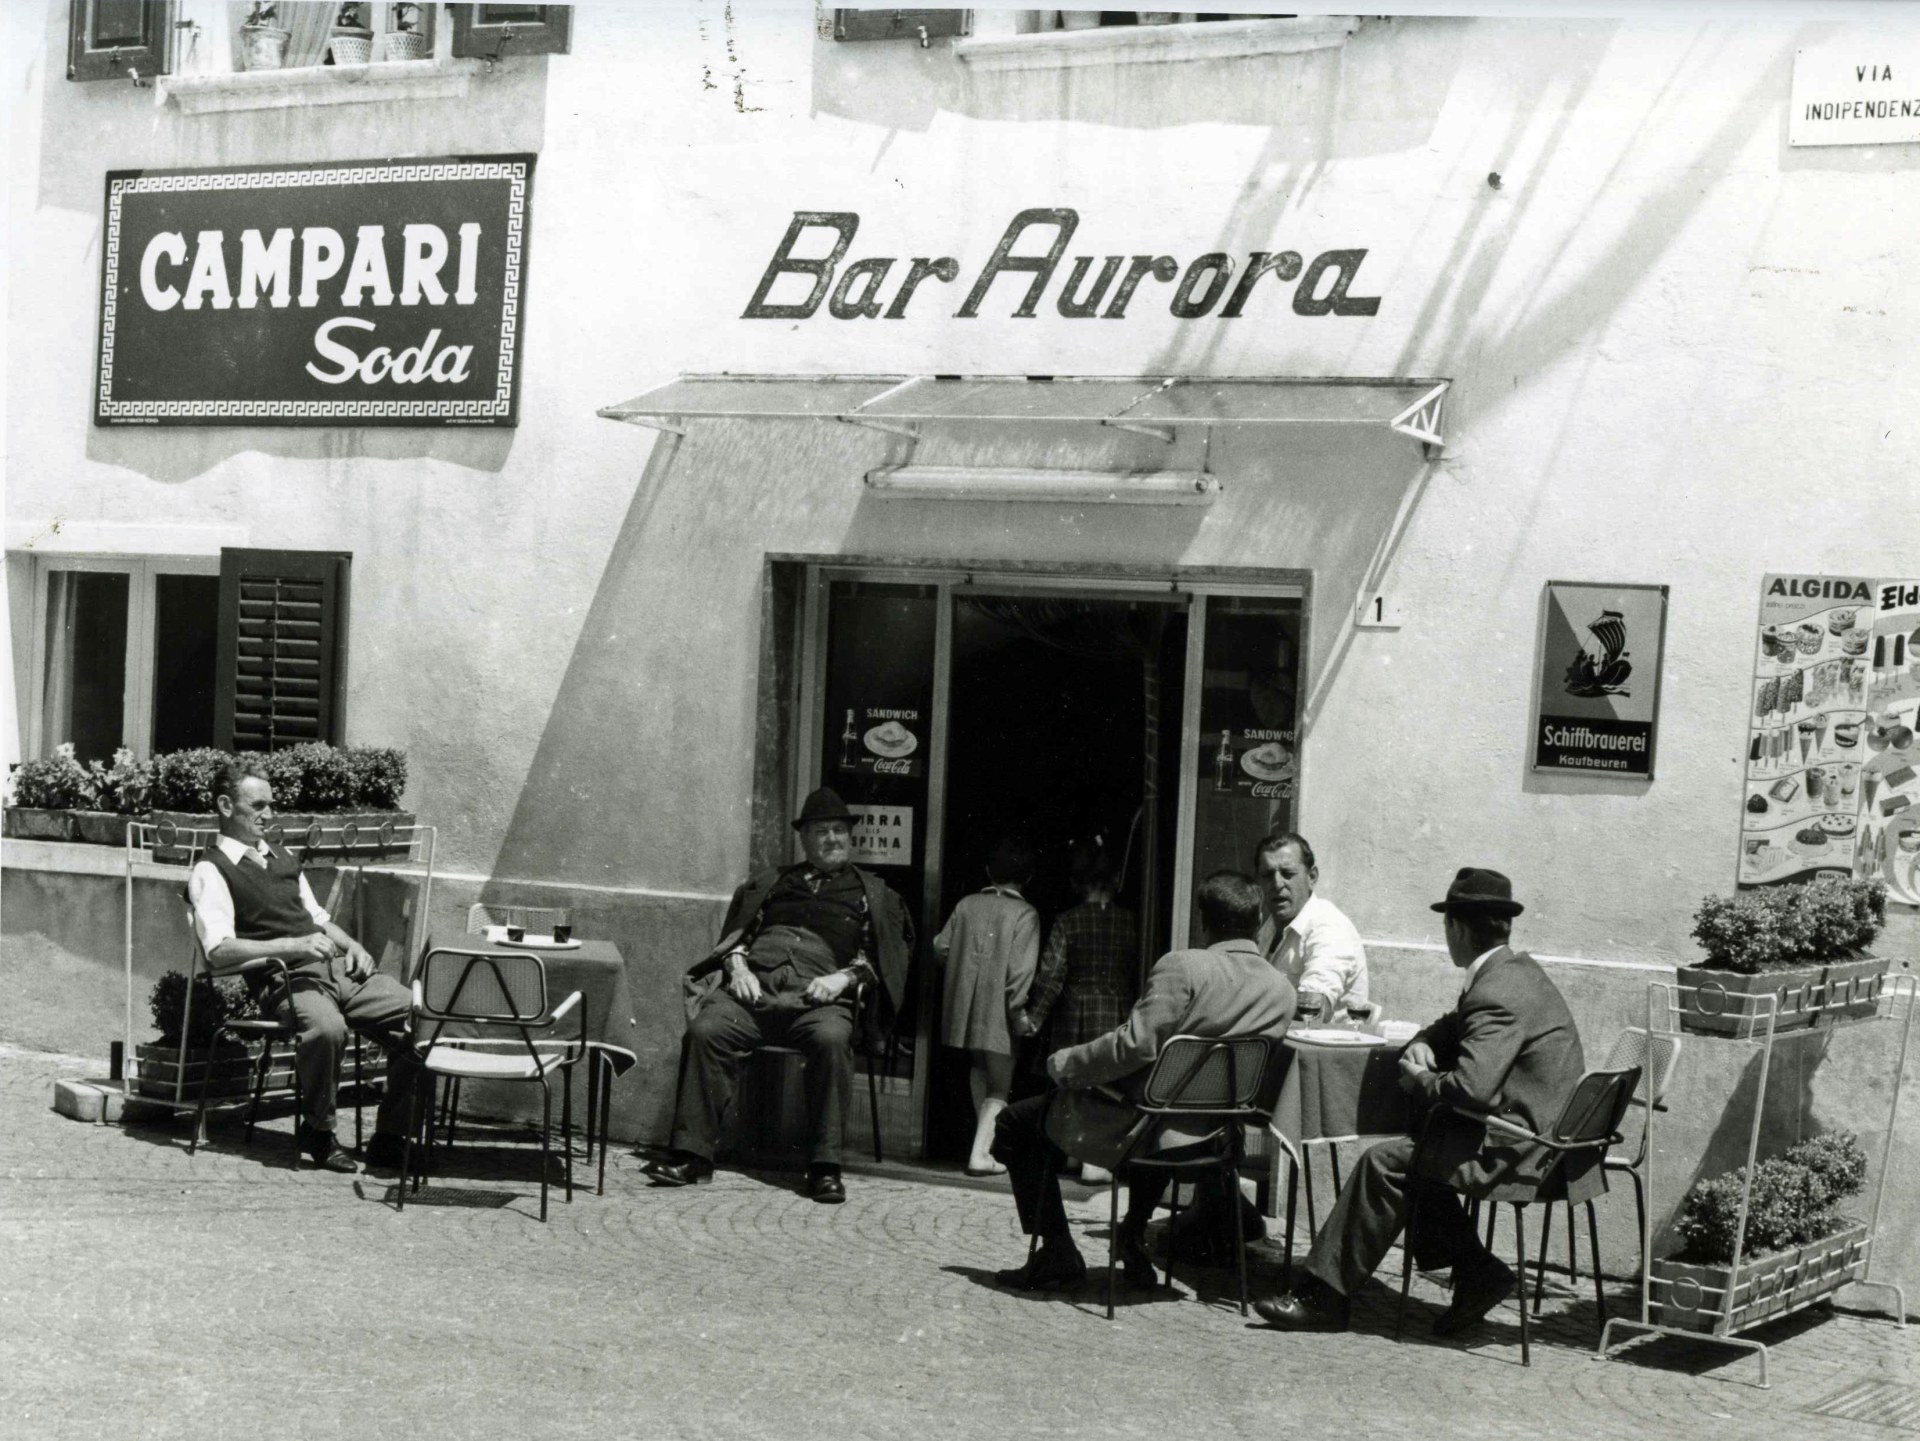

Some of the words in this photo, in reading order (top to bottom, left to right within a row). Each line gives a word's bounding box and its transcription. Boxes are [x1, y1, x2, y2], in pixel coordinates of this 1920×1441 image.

[1856, 64, 1892, 82] VIA
[140, 222, 482, 311] CAMPARI
[739, 211, 960, 319] Bar
[953, 207, 1382, 319] Aurora
[305, 316, 474, 384] Soda
[1767, 578, 1872, 600] ALGIDA
[1375, 597, 1382, 622] 1
[866, 708, 918, 720] SANDWICH
[1243, 728, 1294, 741] SANDWIC
[1544, 725, 1646, 751] Schiffbrauerei
[1559, 754, 1628, 769] Kaufbeuren
[861, 814, 901, 826] IRRA
